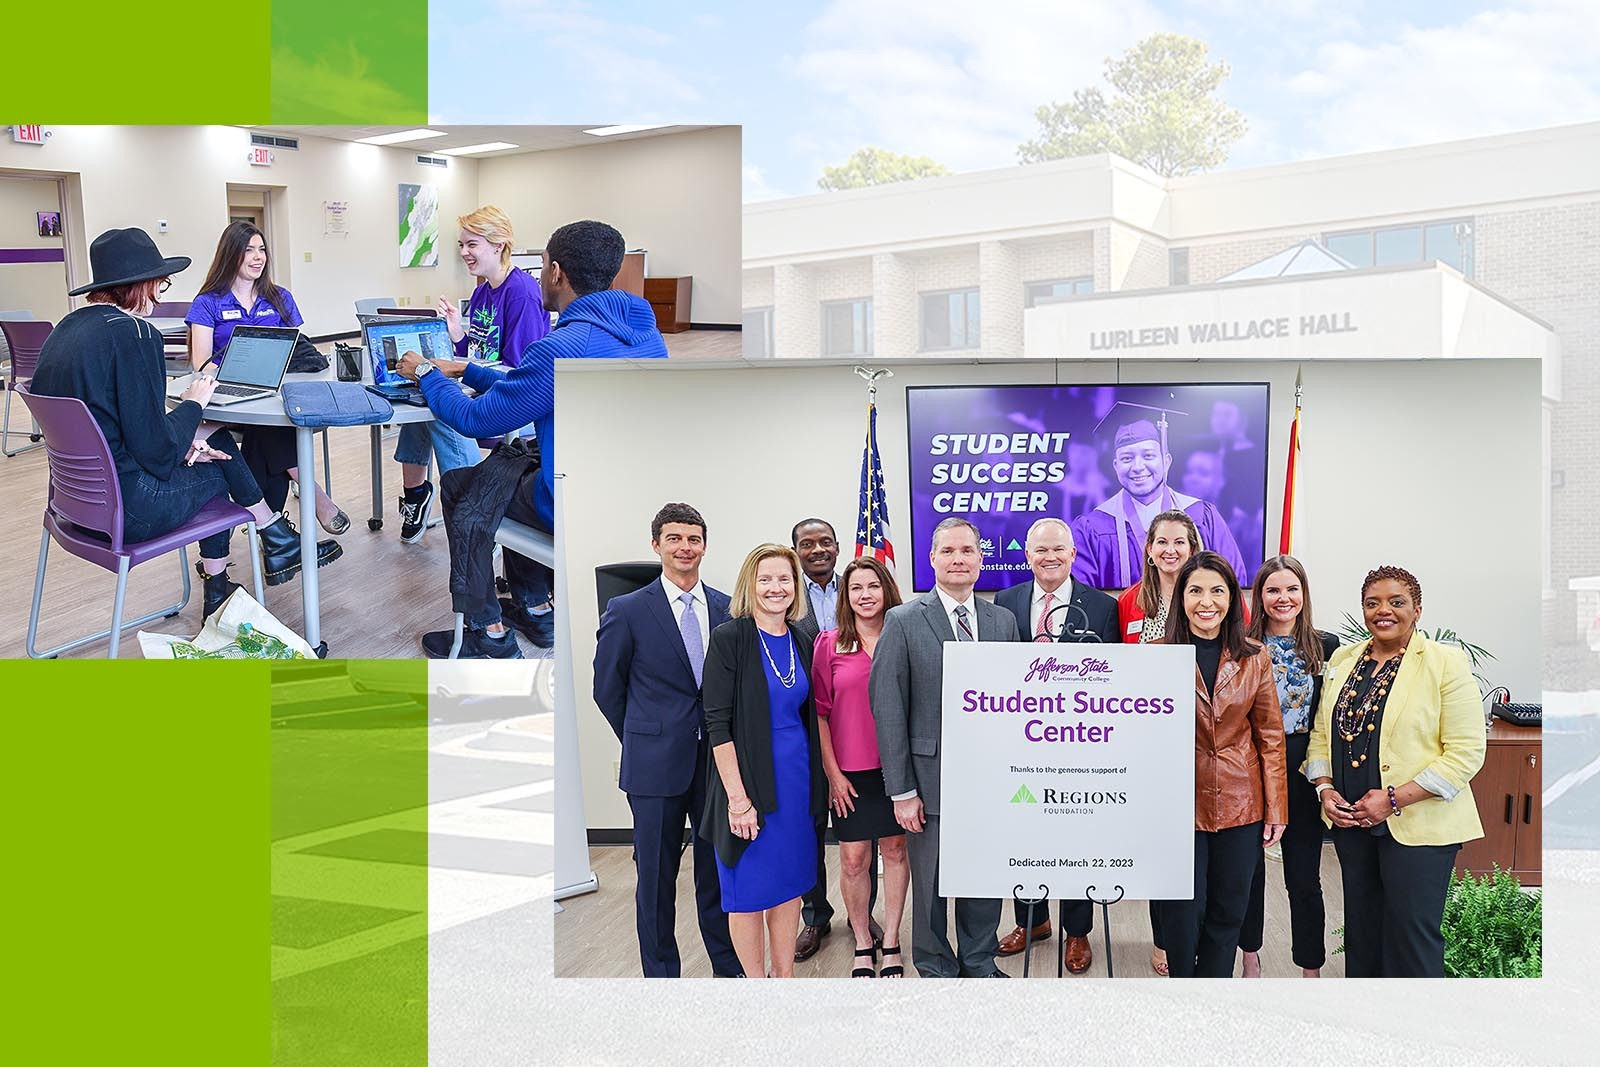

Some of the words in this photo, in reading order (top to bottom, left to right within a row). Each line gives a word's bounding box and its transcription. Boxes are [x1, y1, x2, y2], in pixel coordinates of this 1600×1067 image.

[18, 124, 41, 141] EXIT
[255, 148, 268, 163] EXIT
[1090, 326, 1179, 351] LURLEEN
[1188, 318, 1289, 344] WALLACE
[1300, 312, 1358, 336] HALL
[930, 432, 1070, 456] STUDENT
[931, 461, 1065, 485] SUCCESS
[932, 491, 1049, 513] CENTER
[980, 562, 1032, 571] onstate.edu
[1024, 656, 1079, 683] Jefferson
[1078, 657, 1113, 677] State
[1052, 675, 1087, 683] Community
[1088, 675, 1110, 683] College
[962, 689, 1066, 714] Student
[1073, 690, 1175, 715] Success
[1024, 719, 1114, 743] Center
[1045, 766, 1057, 774] the
[1058, 767, 1090, 775] generous
[1091, 767, 1118, 775] support
[1043, 807, 1094, 815] FOUNDATION
[1009, 858, 1056, 868] Dedicated
[1059, 858, 1088, 868] March
[1092, 858, 1107, 869] 22,
[1109, 858, 1134, 868] 2023
